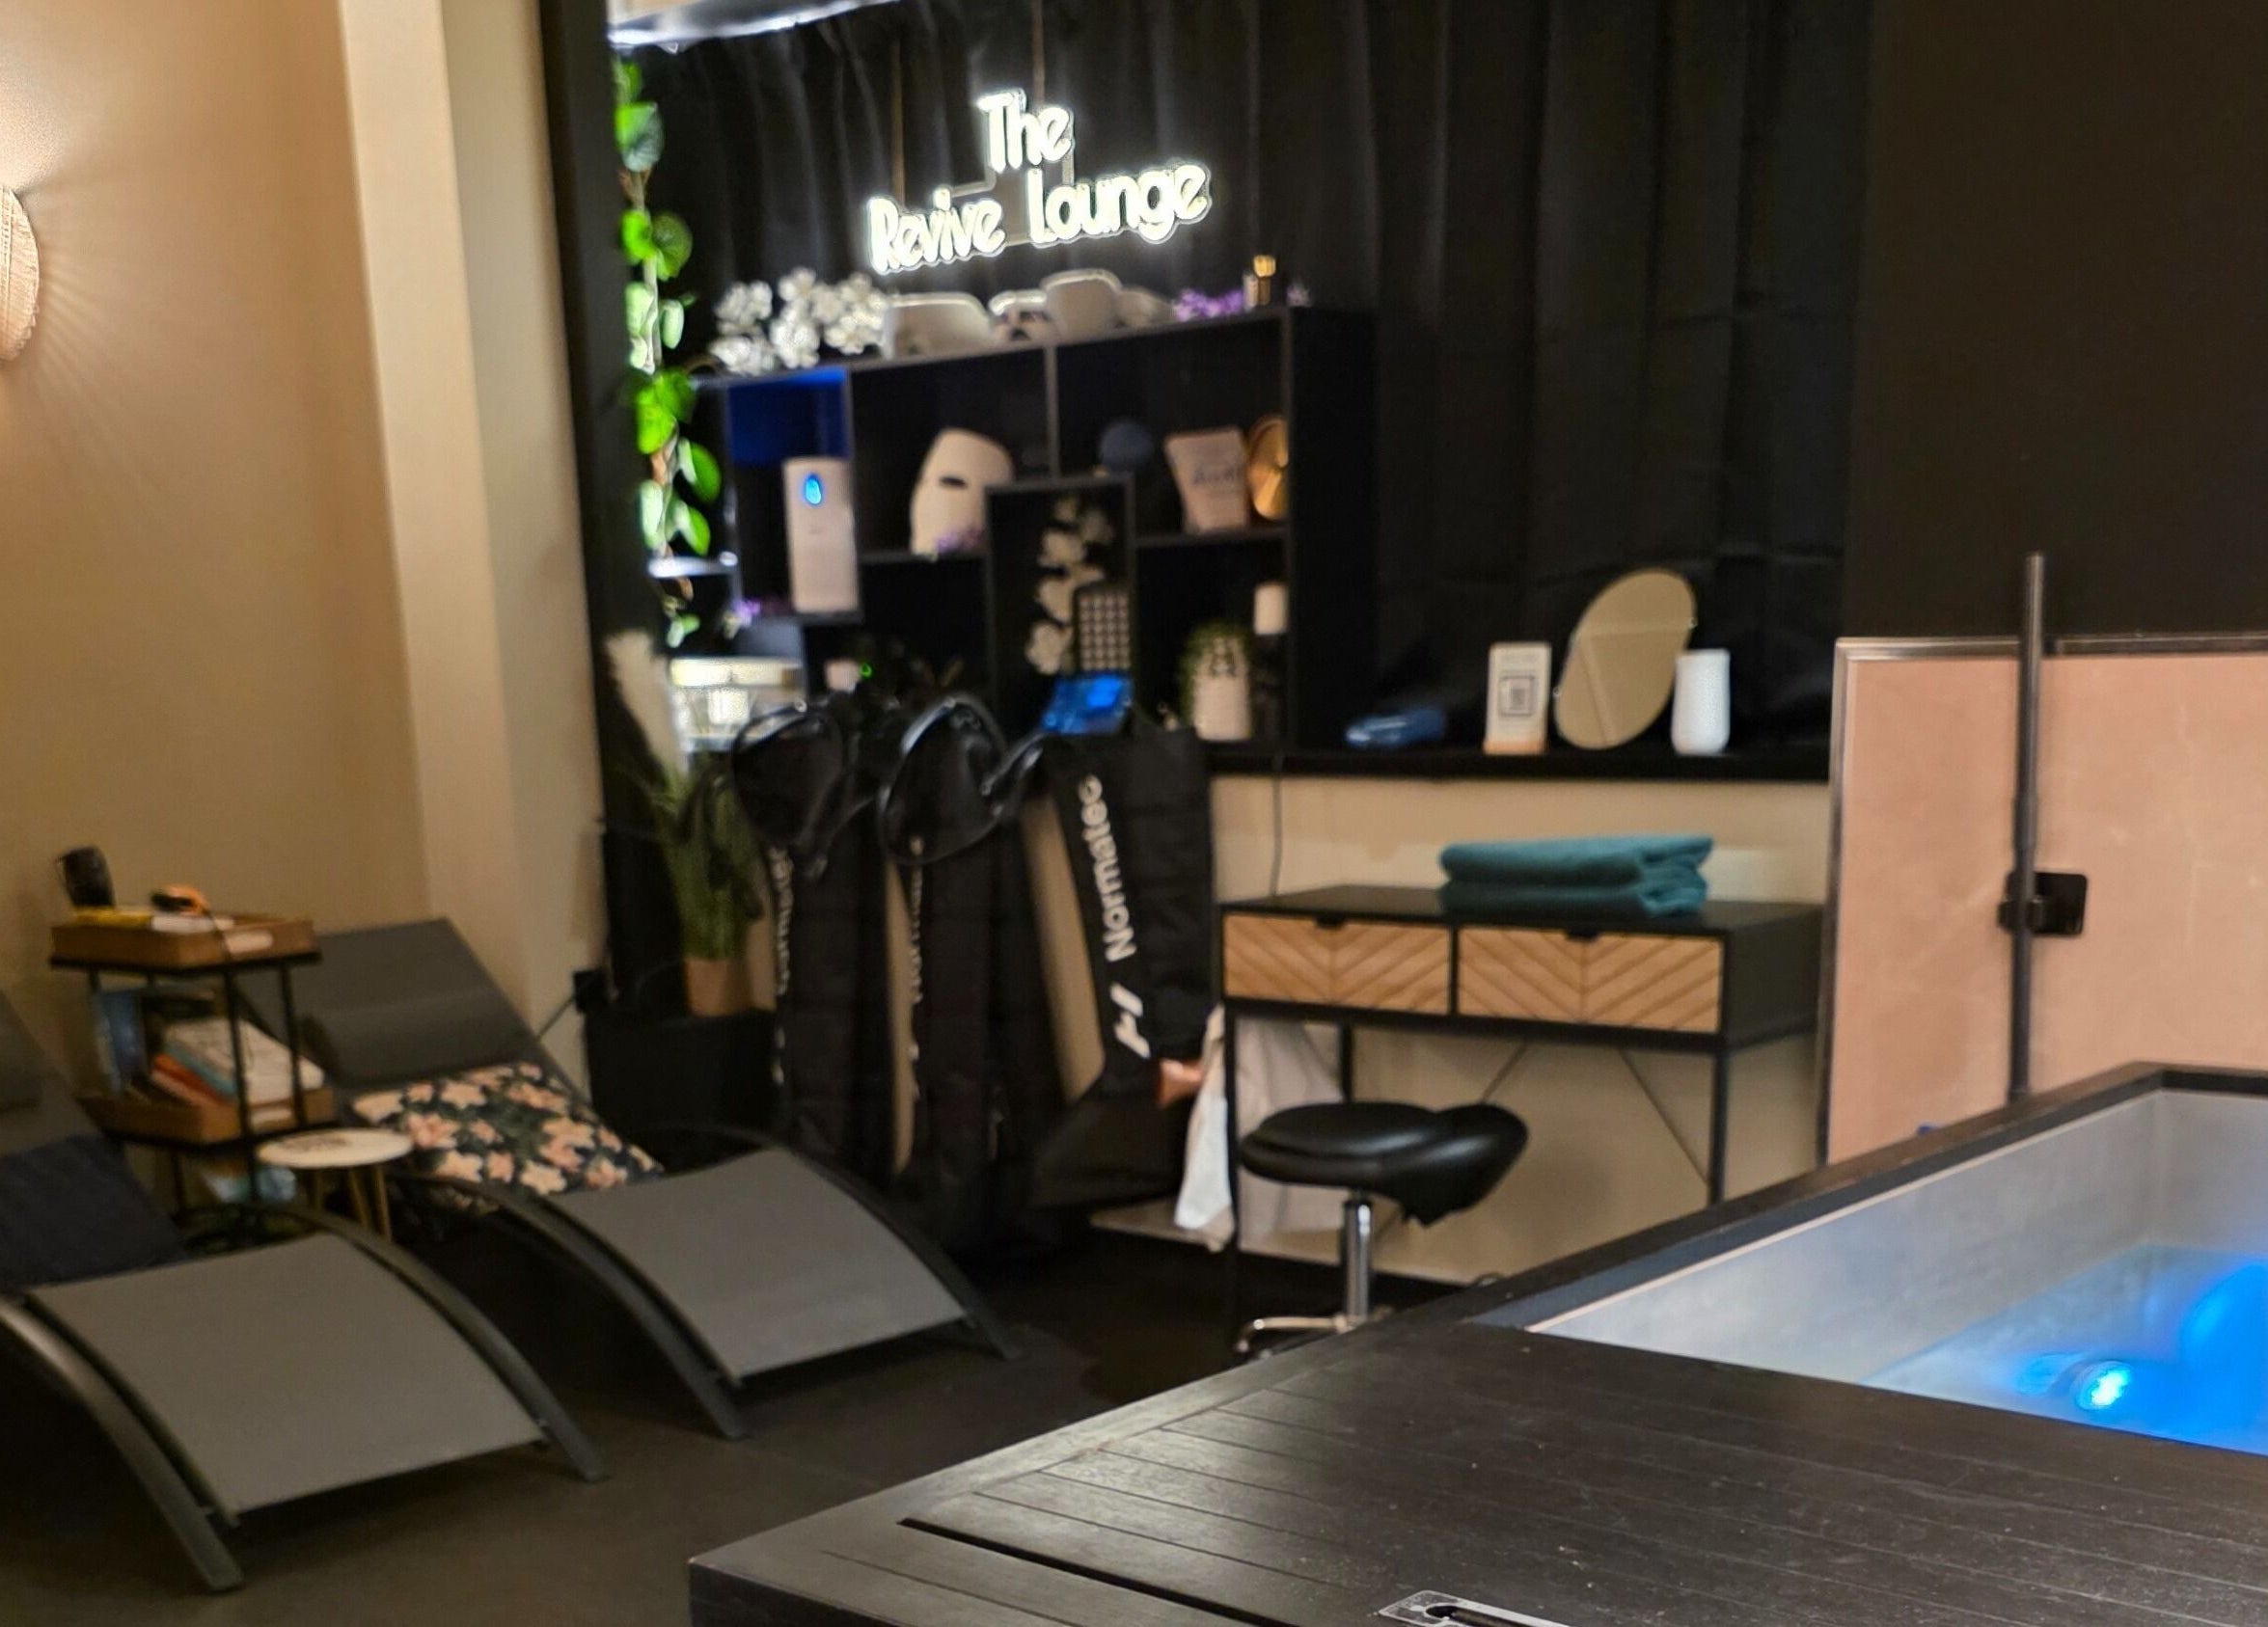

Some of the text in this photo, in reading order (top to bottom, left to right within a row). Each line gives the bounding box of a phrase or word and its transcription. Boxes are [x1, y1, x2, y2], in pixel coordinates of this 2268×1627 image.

[977, 88, 1073, 173] The
[867, 164, 1210, 273] Revive Lounge
[1078, 774, 1137, 963] Normatec
